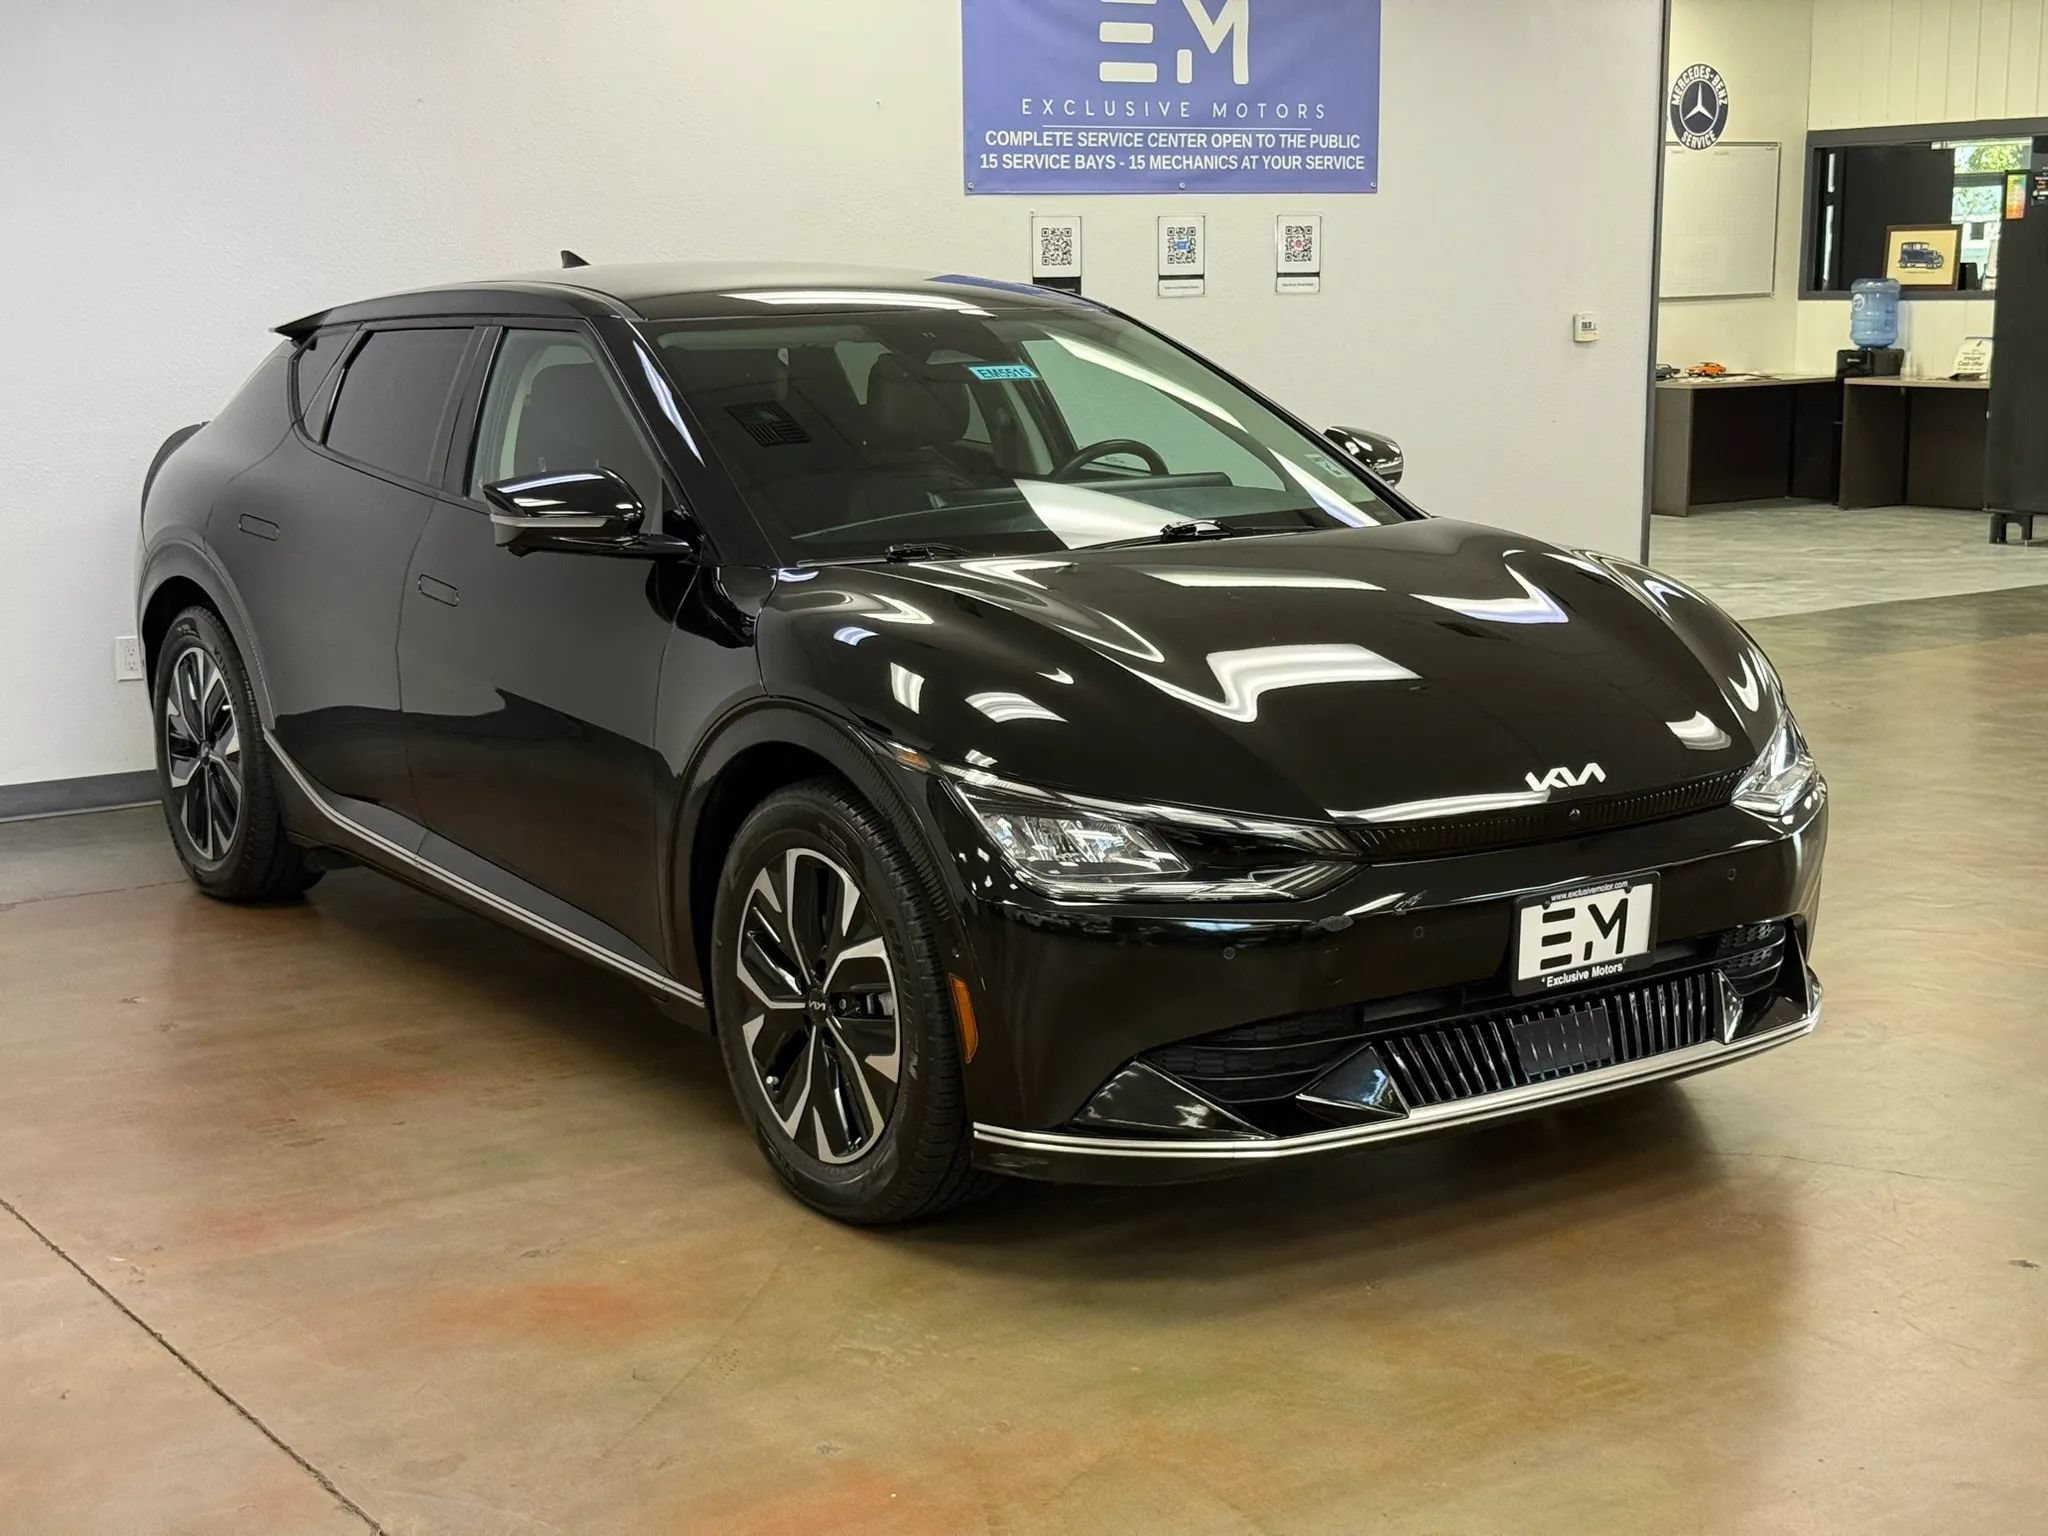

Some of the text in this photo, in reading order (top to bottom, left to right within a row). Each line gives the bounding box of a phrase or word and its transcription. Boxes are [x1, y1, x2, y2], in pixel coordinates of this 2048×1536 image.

[1021, 98, 1326, 120] EXCLUSIVE MOTORS
[985, 130, 1361, 149] COMPLETE SERVICE CENTER OPEN TO THE PUBLIC
[1681, 129, 1717, 149] SERVICE
[979, 153, 998, 170] 15
[1001, 154, 1070, 170] SERVICE
[1074, 154, 1116, 170] BAYS
[1128, 155, 1146, 170] 15
[1149, 155, 1238, 170] MECHANICS
[1240, 155, 1260, 170] AT
[1262, 155, 1302, 170] YOUR
[1305, 156, 1365, 170] SERVICE
[977, 368, 1032, 379] EM5515
[1525, 762, 1607, 792] KIA
[1551, 880, 1629, 901] www.exclusivemotor.com
[1540, 897, 1629, 970] EM
[1546, 962, 1624, 988] Exclusive Motors
